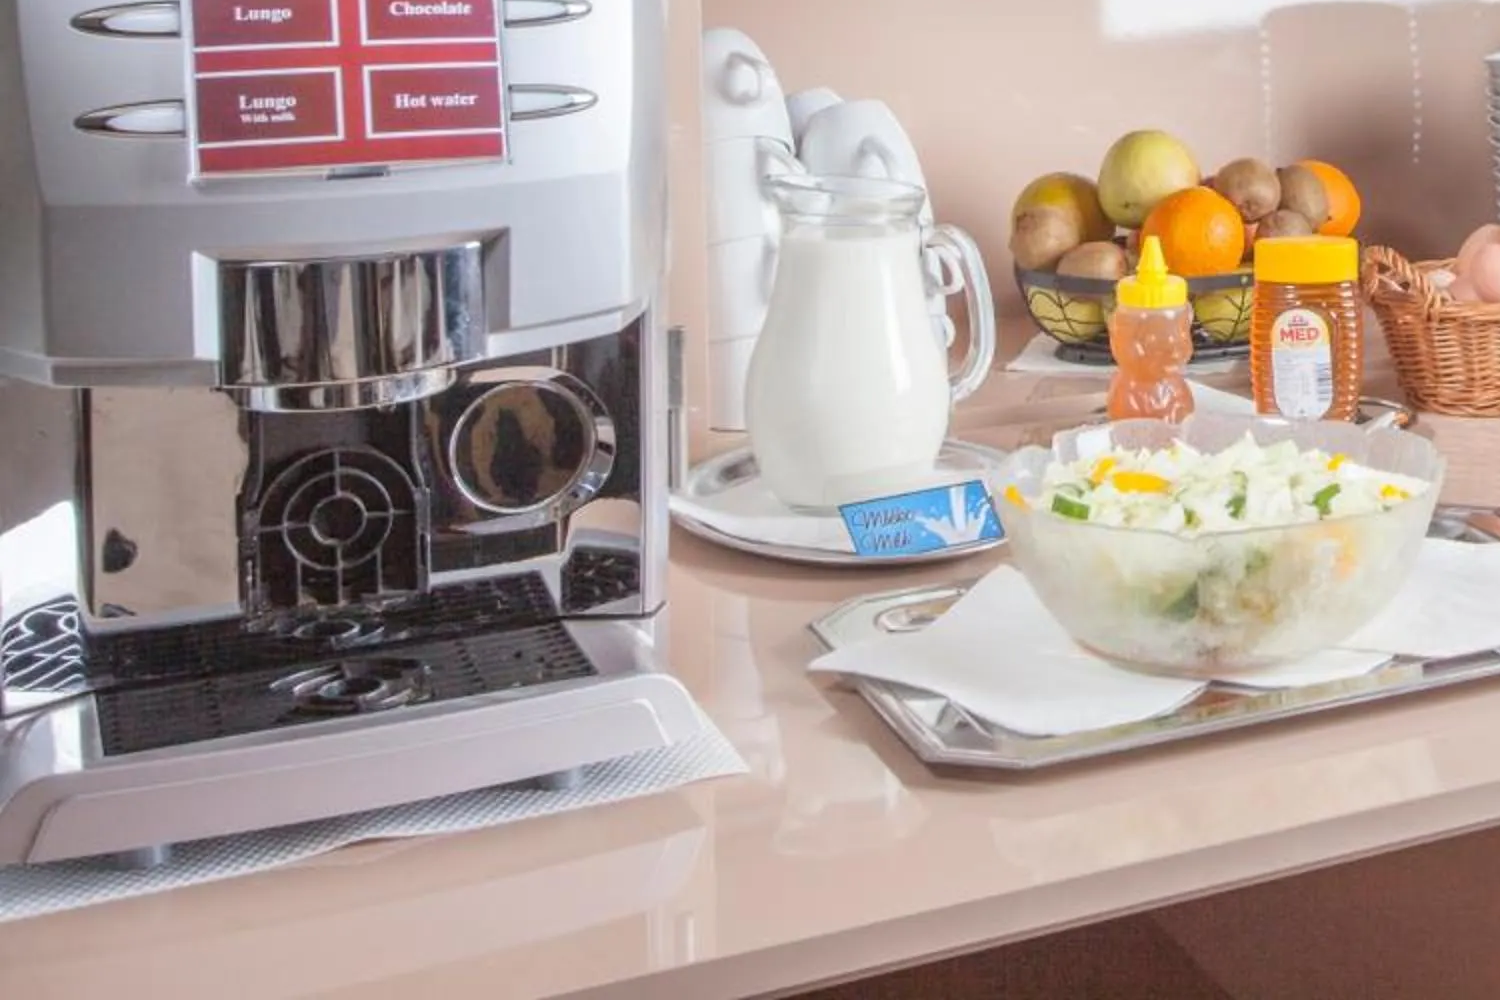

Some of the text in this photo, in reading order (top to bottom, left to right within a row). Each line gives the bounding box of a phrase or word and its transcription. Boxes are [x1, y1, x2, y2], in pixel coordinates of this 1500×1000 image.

[234, 6, 293, 24] Lungo
[389, 0, 472, 16] Chocolate
[239, 94, 297, 111] Lungo
[394, 93, 479, 109] Hot water
[1279, 326, 1320, 343] MED
